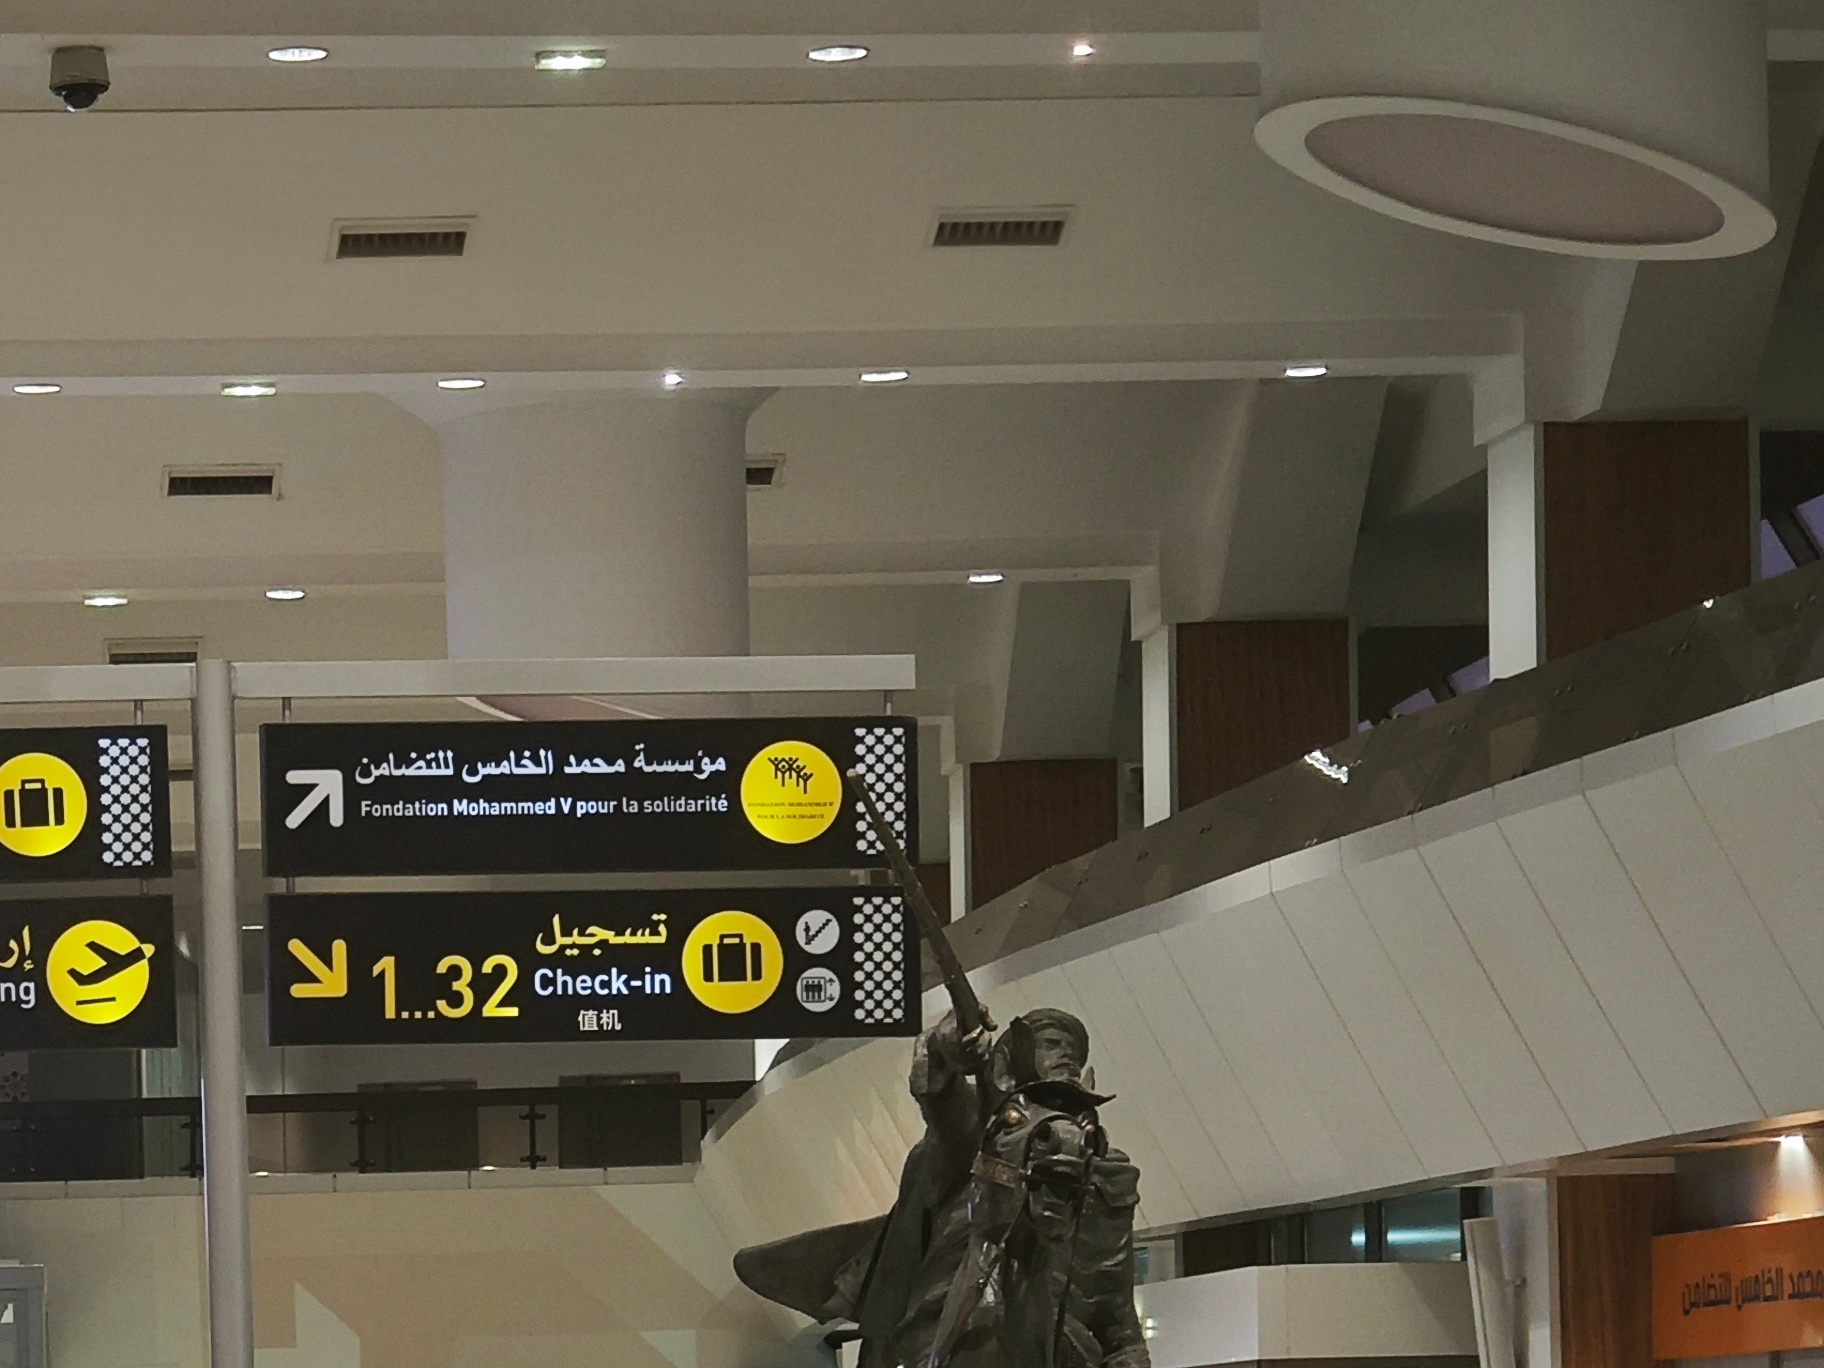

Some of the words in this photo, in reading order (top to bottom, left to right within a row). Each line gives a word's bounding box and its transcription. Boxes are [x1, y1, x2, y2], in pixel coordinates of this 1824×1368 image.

[356, 750, 453, 784] للتضامن
[462, 749, 553, 783] الخامس
[564, 755, 625, 773] محمد
[634, 748, 726, 779] مؤسسة
[362, 800, 448, 816] Fondation
[453, 798, 555, 815] Mohammed
[560, 797, 572, 814] V
[577, 801, 617, 817] pour
[623, 797, 638, 812] la
[644, 794, 728, 812] solidarité
[536, 914, 667, 955] تسجيل
[535, 967, 671, 995] Check-in
[578, 1010, 621, 1030] 值机
